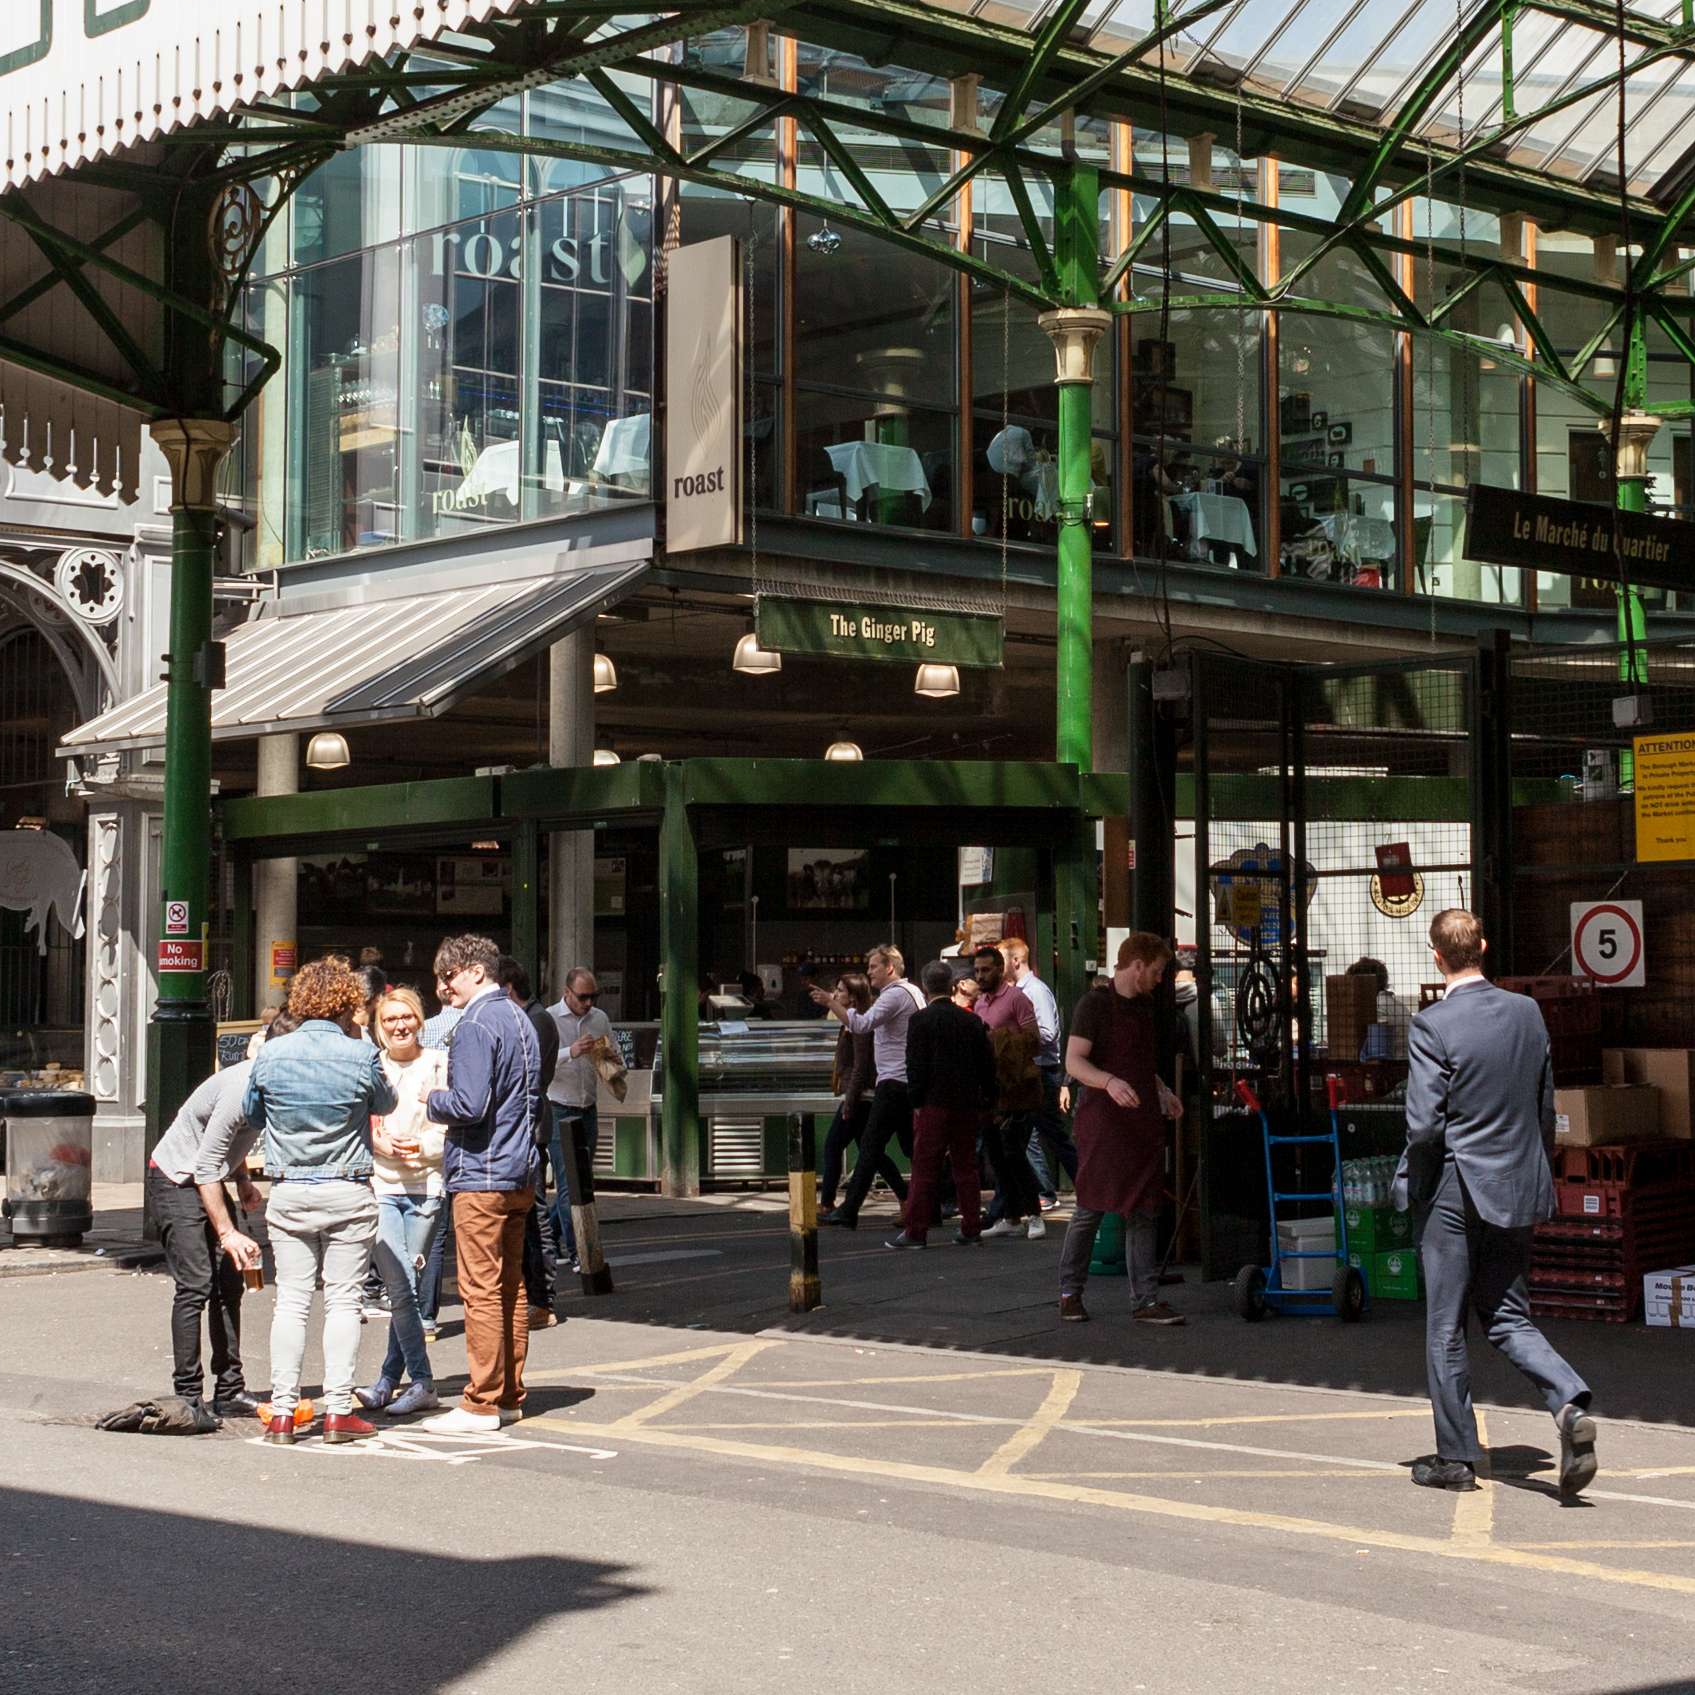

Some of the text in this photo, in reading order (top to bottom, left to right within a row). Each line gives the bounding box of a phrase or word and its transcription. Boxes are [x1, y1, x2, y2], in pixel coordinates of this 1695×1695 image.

[674, 466, 725, 499] roast
[1513, 512, 1531, 540] Le
[1535, 514, 1588, 548] Marché
[830, 614, 935, 647] The Ginger Pig
[167, 944, 183, 954] No
[1598, 929, 1617, 960] 5
[159, 955, 198, 968] moking
[1655, 1282, 1685, 1292] Moue
